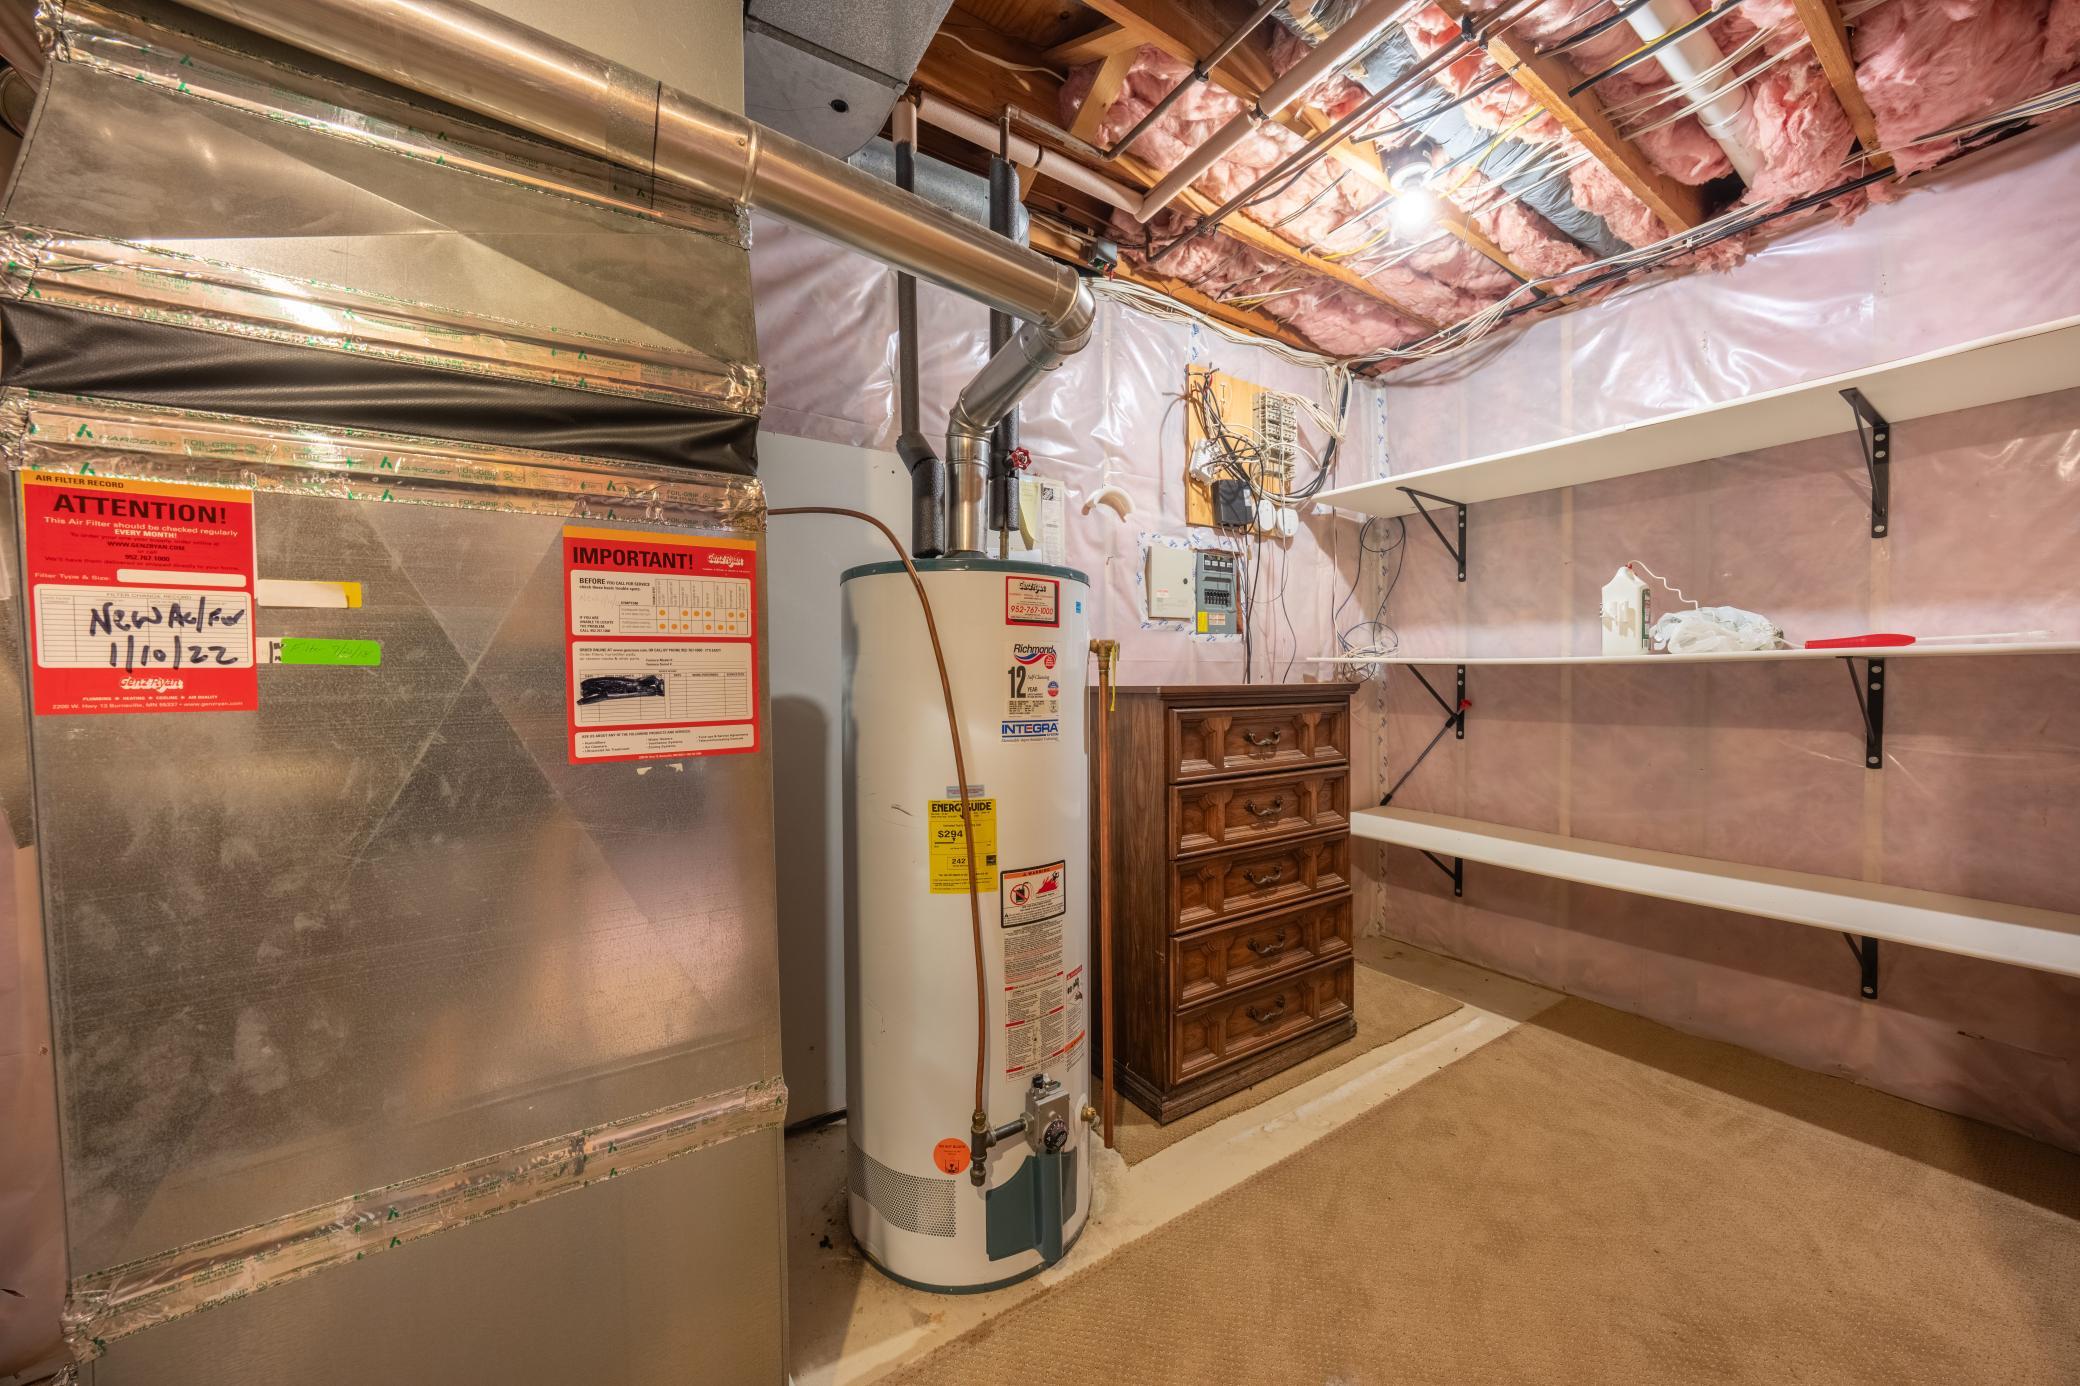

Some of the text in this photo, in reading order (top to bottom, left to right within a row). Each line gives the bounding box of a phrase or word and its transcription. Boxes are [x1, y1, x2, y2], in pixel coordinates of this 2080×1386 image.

[35, 474, 124, 489] AIR FILTER RECORD
[52, 494, 227, 524] ATTENTION!
[44, 516, 66, 526] This
[68, 518, 84, 526] Air
[86, 519, 112, 528] Filter
[113, 521, 146, 531] should
[161, 525, 198, 535] checked
[200, 528, 238, 537] regularly
[143, 530, 177, 538] MONTH!
[572, 546, 694, 570] IMPORTANT!
[60, 573, 80, 581] Type
[1010, 606, 1053, 615] 952-767-1000
[89, 602, 162, 636] New
[110, 635, 238, 674] 1/10/22
[1014, 644, 1054, 654] Richmond
[1008, 666, 1026, 698] 12
[1002, 723, 1058, 734] INTEGRA
[938, 830, 963, 838] $294
